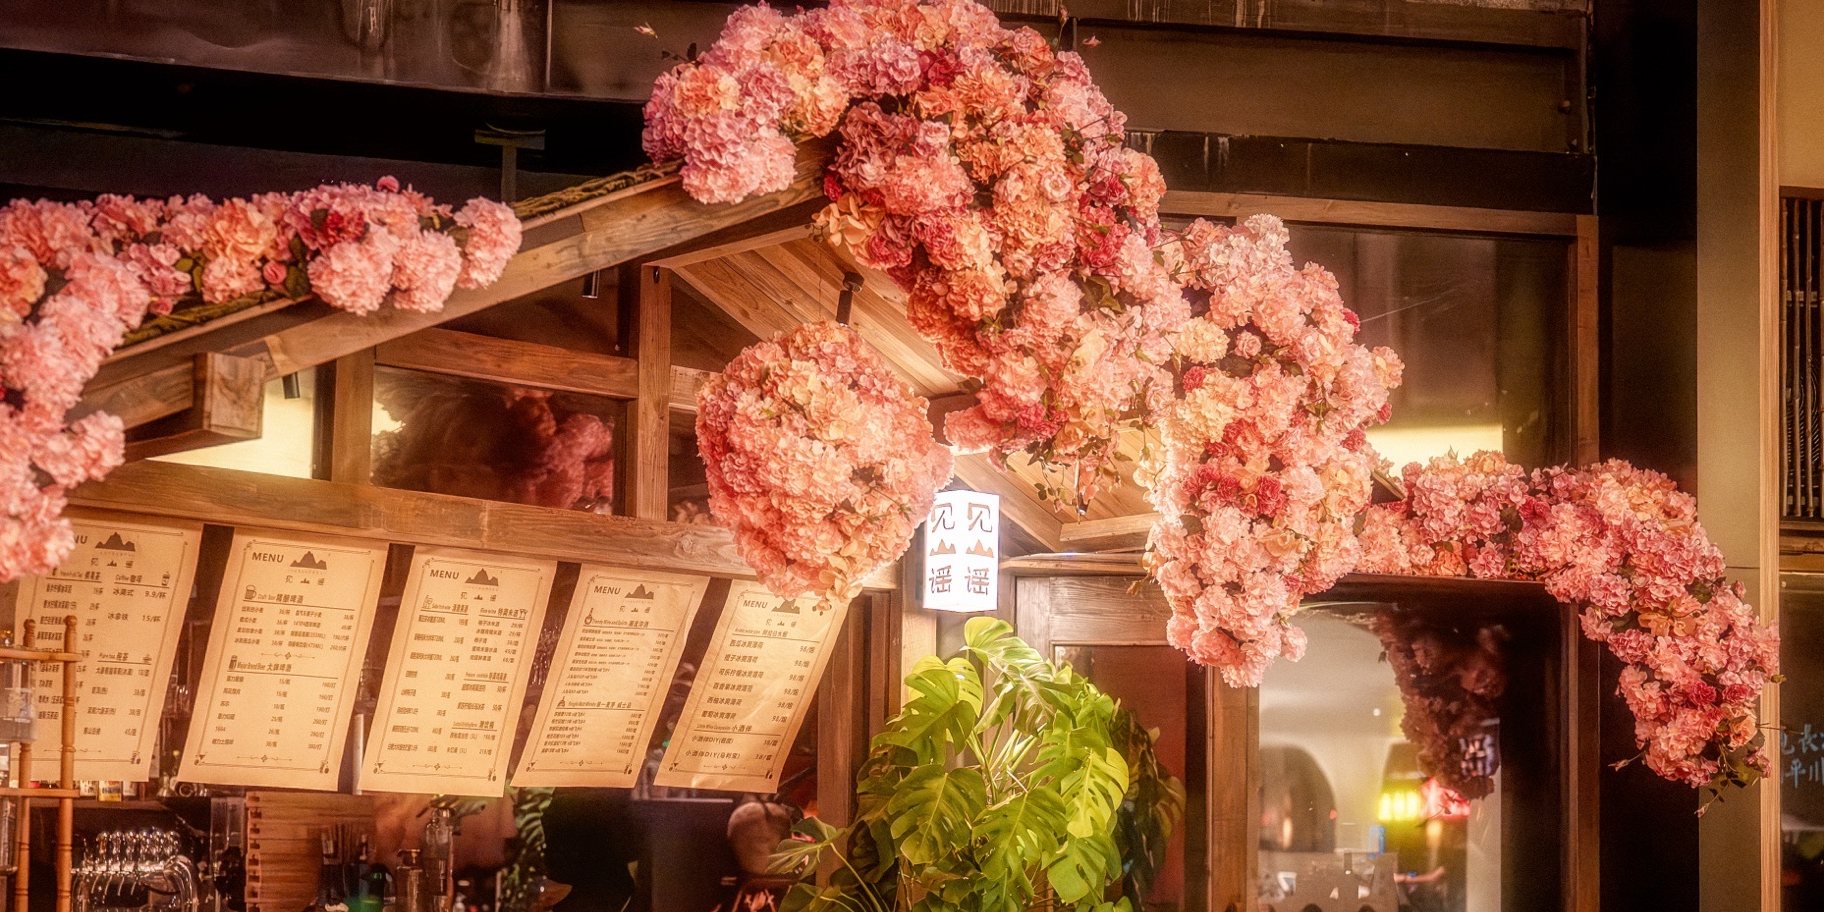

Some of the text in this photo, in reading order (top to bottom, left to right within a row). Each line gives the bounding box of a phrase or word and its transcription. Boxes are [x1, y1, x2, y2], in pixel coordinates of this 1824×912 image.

[252, 552, 284, 563] MENU
[430, 569, 460, 580] MENU
[112, 587, 166, 599] 冰美式 9.9/杯
[594, 585, 621, 595] MENU
[743, 599, 768, 609] MENU
[108, 612, 128, 620] 冰拿铁
[266, 662, 292, 672] 大牌啤酒
[731, 724, 752, 732] 小酒伴
